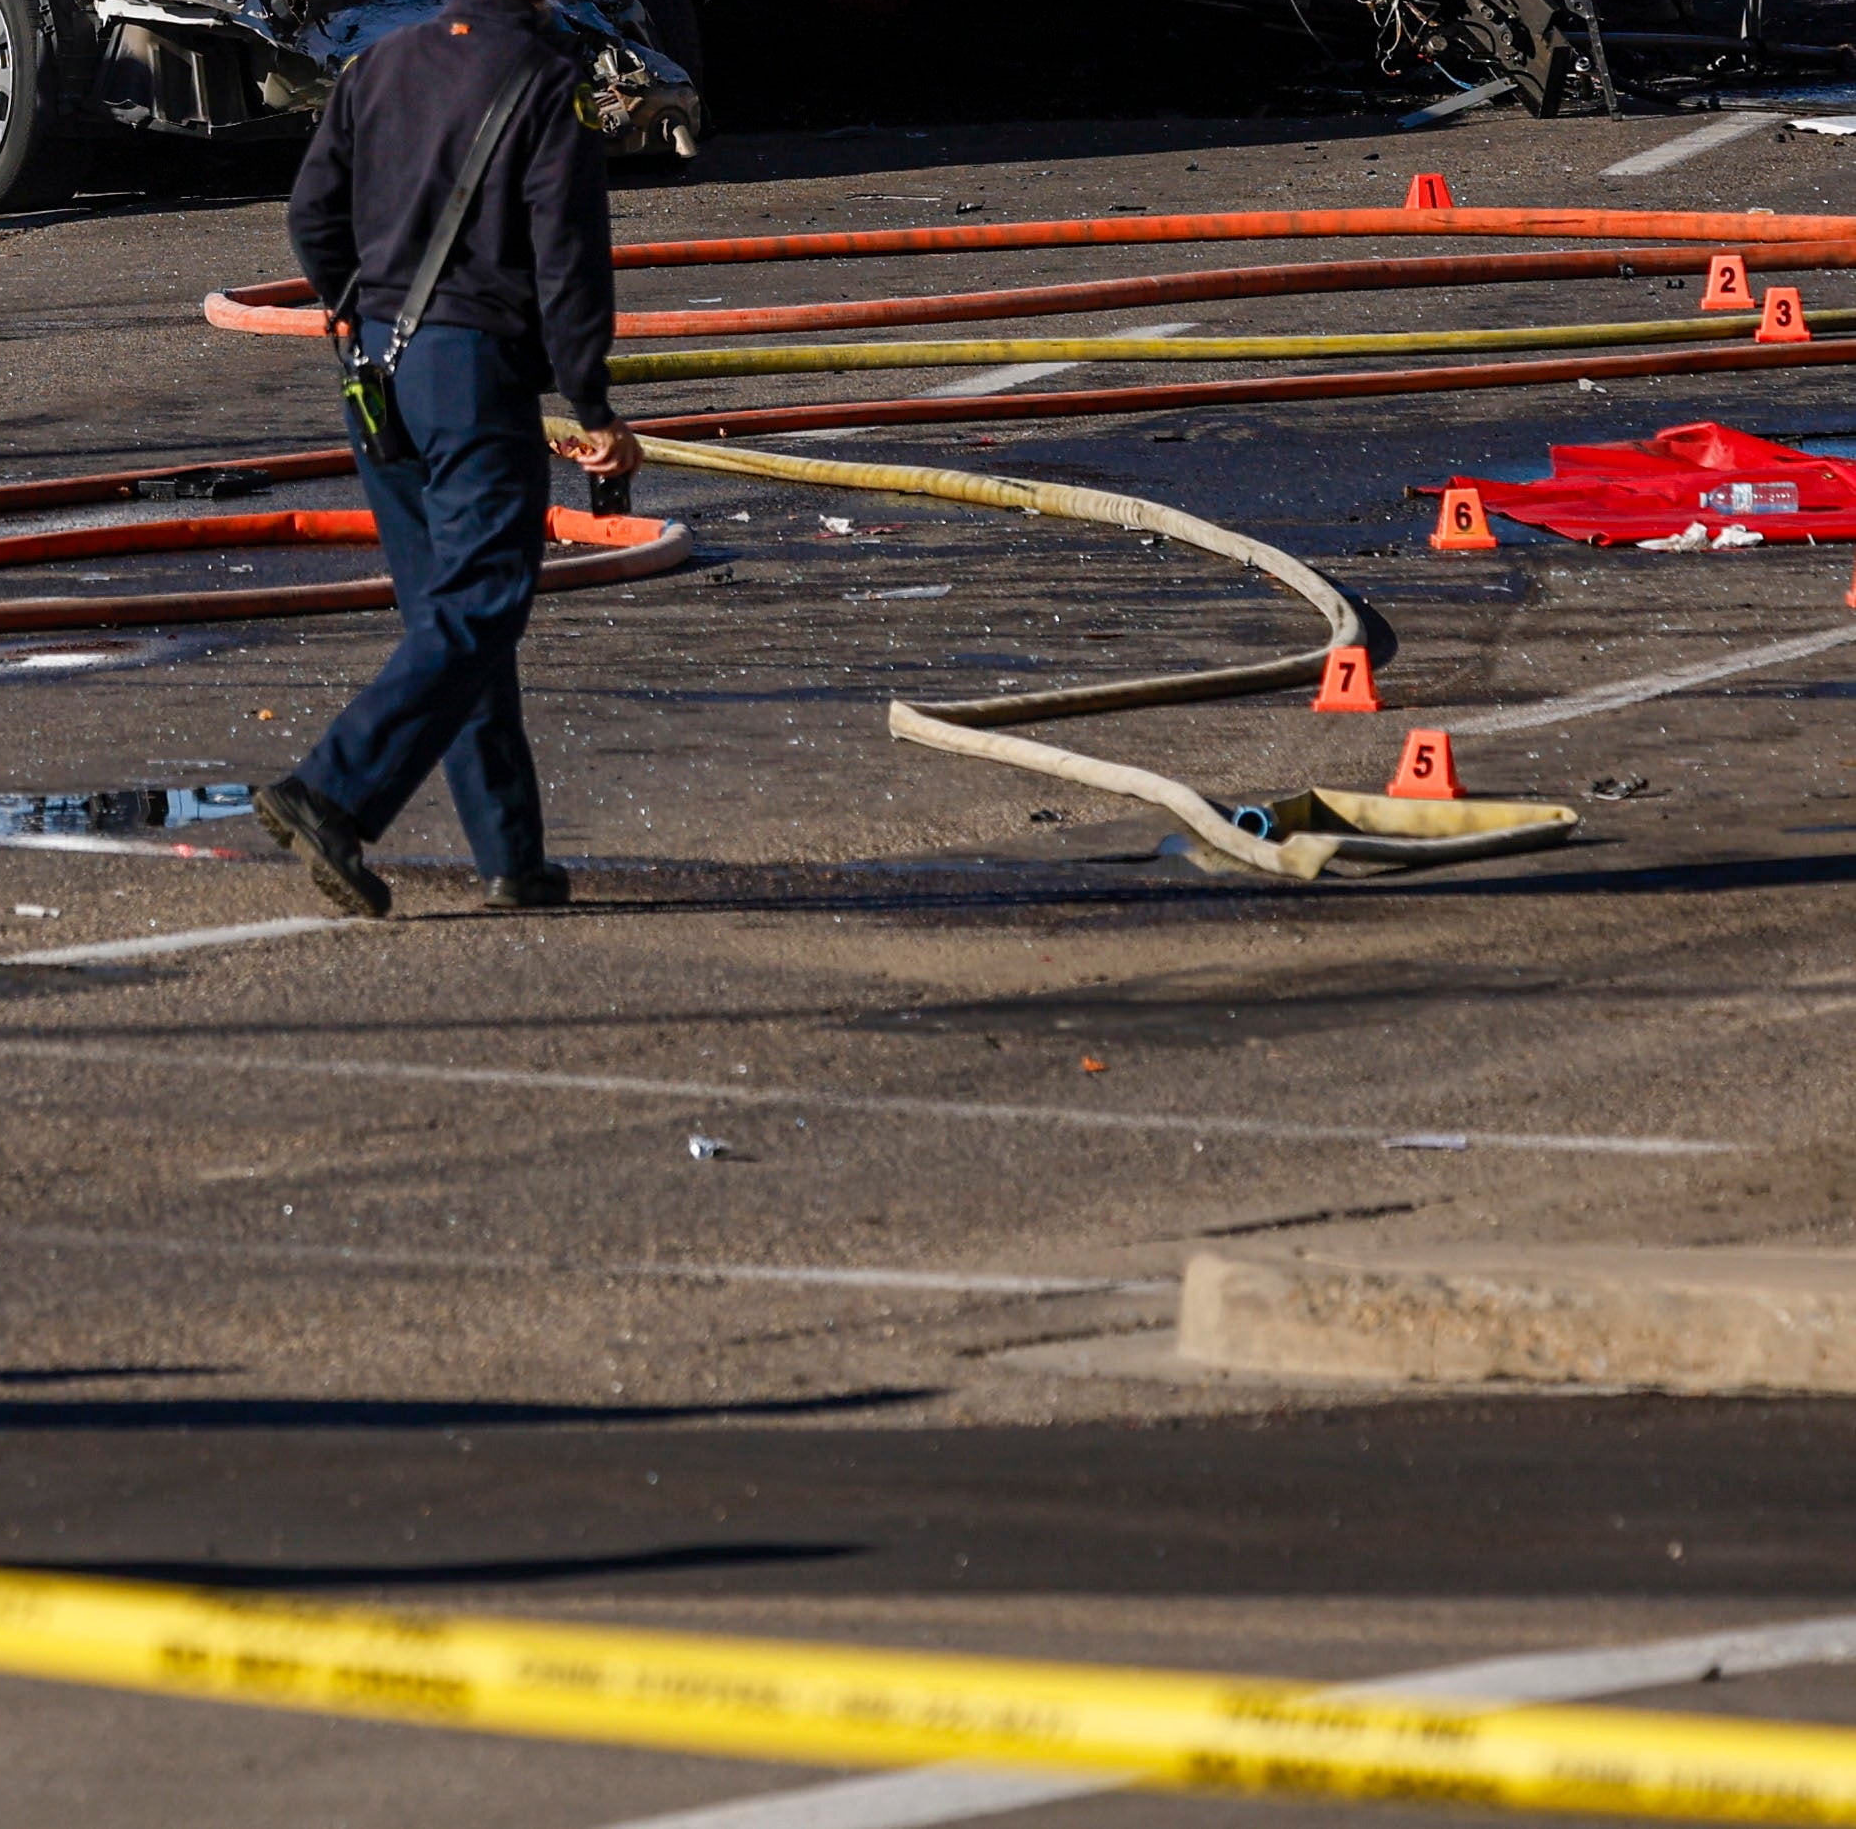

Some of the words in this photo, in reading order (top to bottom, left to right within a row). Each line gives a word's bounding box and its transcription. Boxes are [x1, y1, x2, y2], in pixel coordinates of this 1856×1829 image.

[1424, 178, 1438, 209] 1
[1719, 266, 1737, 293] 2
[1776, 299, 1792, 327] 3
[1455, 501, 1473, 532] 6
[1339, 662, 1356, 692] 7
[1413, 745, 1436, 779] 5
